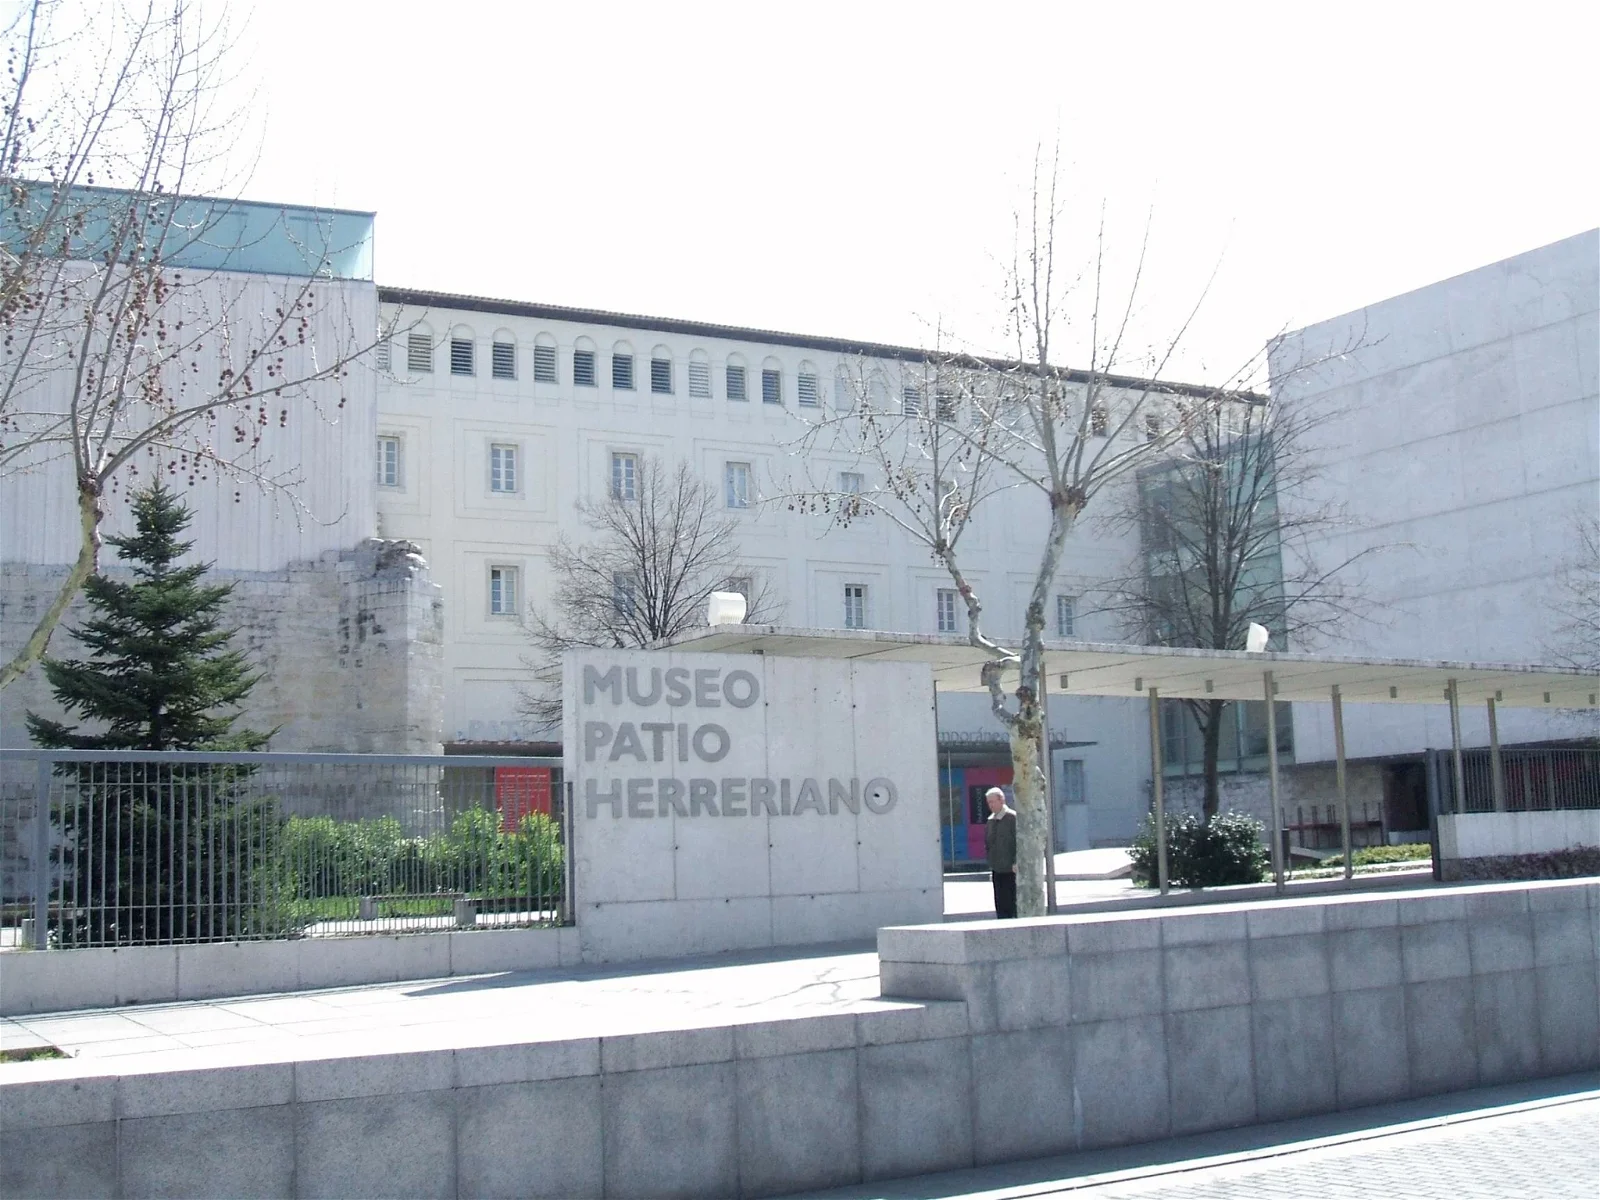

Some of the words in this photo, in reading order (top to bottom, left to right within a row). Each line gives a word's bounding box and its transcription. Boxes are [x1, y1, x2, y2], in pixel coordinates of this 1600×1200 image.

[583, 664, 760, 709] MUSEO
[585, 721, 731, 763] PATIO
[585, 777, 898, 817] HERRERIANO
